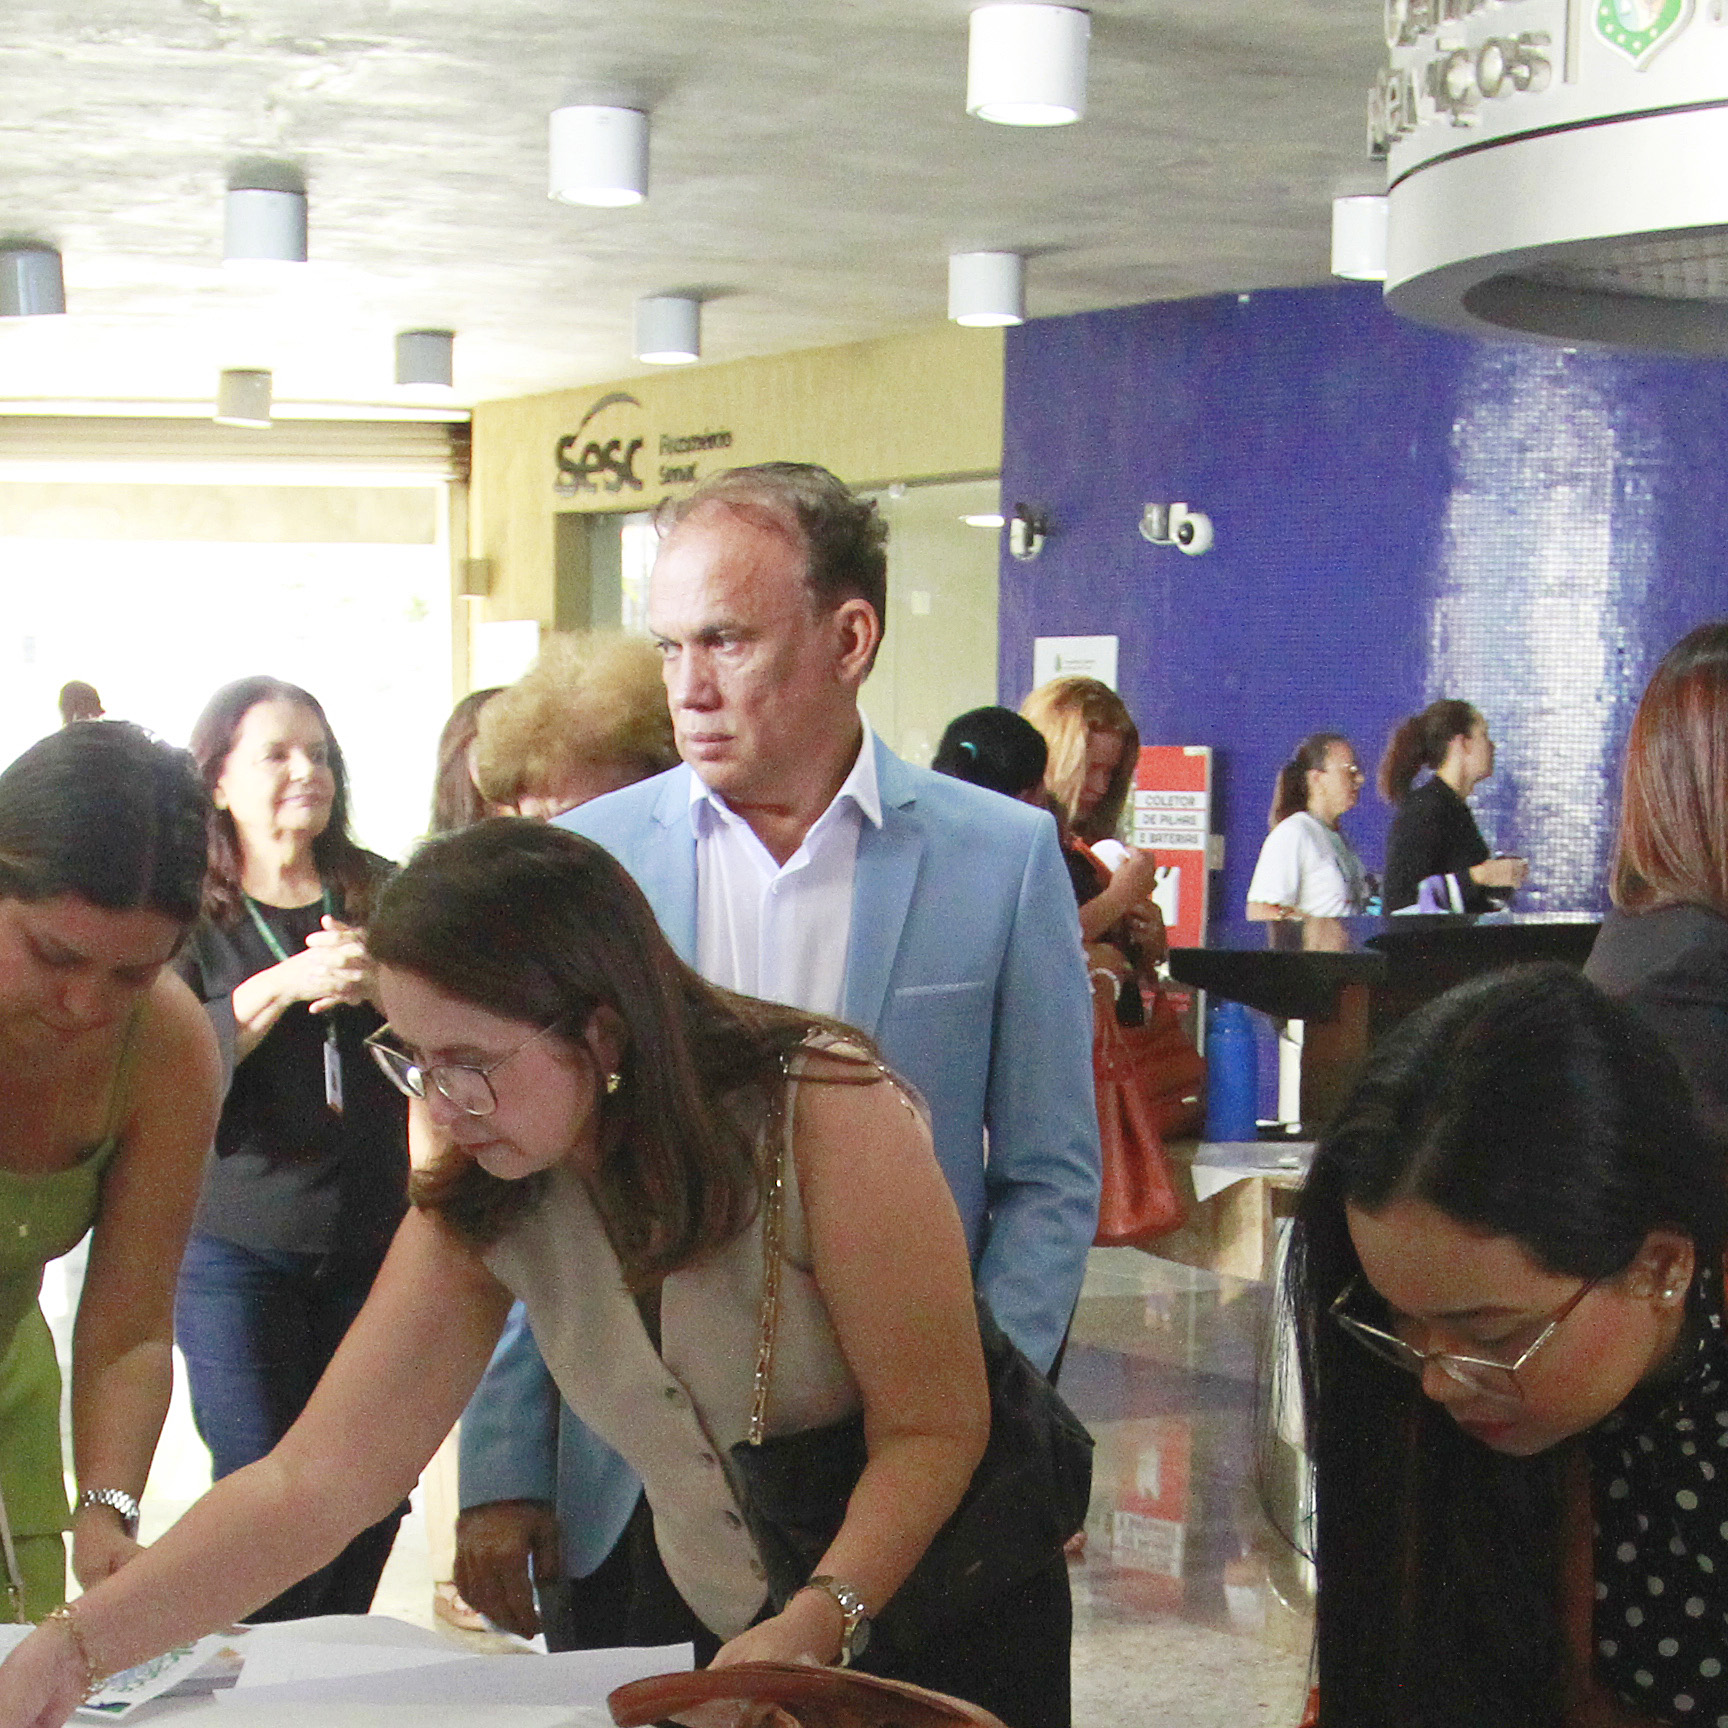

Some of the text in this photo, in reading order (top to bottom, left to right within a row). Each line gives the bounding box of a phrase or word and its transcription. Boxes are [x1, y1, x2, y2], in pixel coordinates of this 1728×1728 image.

[555, 420, 643, 492] Sesc
[1145, 794, 1196, 807] COLETOR
[1143, 814, 1197, 826] DE PILHAS
[1150, 832, 1198, 844] BATERIAS
